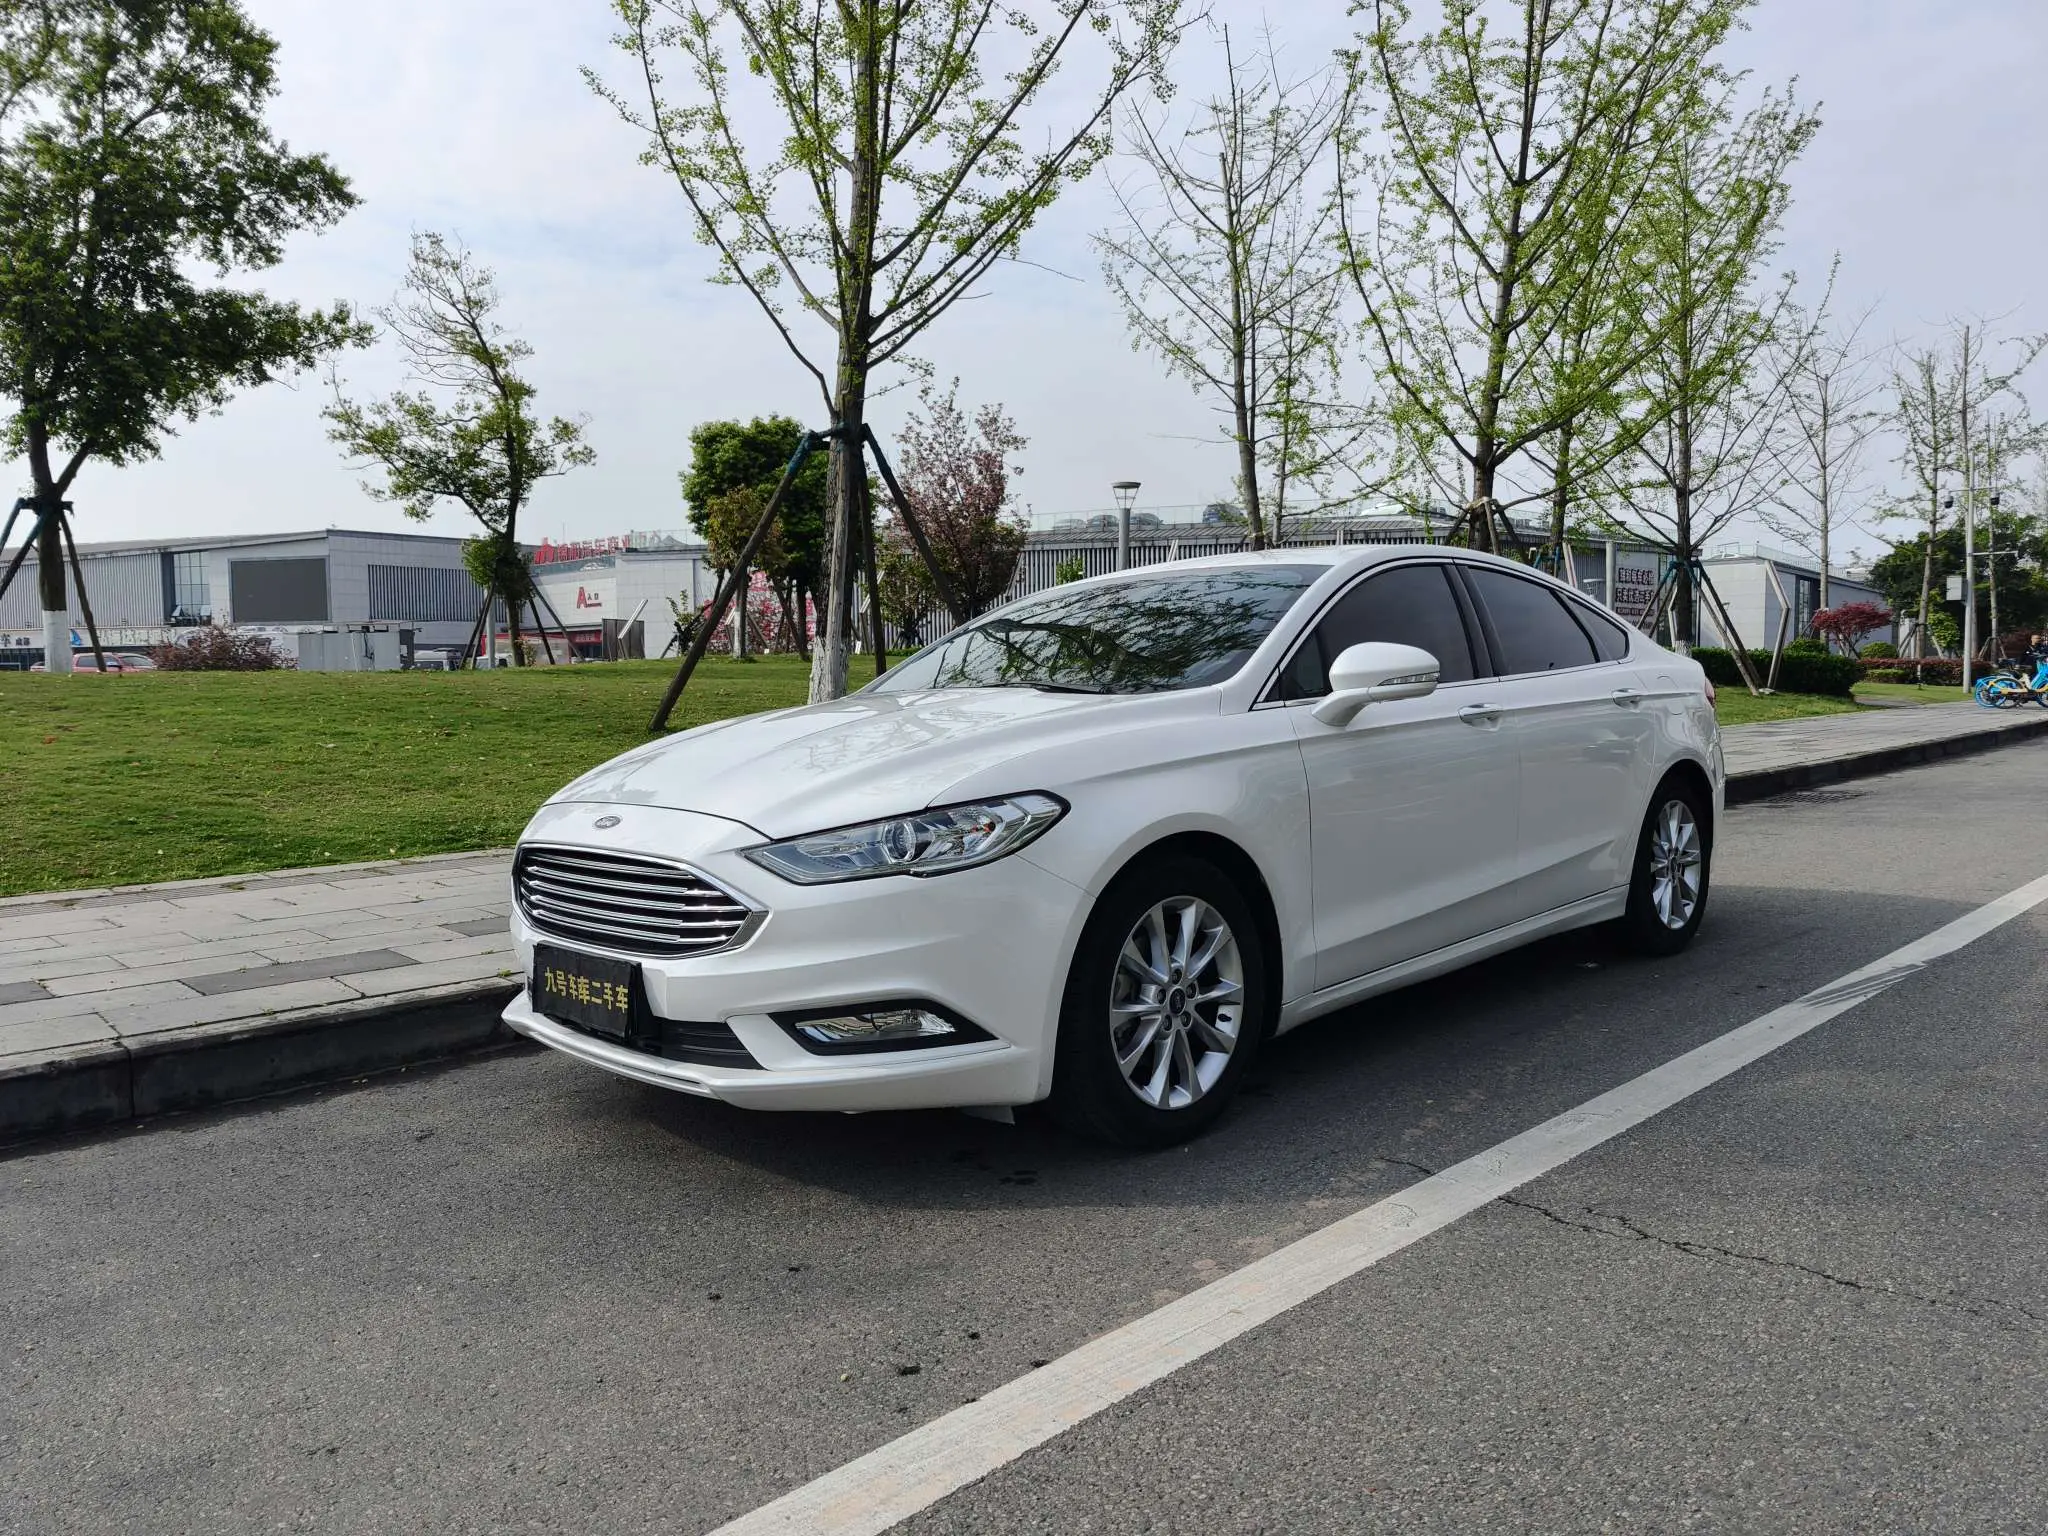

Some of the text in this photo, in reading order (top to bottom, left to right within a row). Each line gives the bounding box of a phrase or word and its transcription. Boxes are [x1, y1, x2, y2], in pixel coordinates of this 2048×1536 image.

[544, 966, 629, 1014] 九号车库二手车
